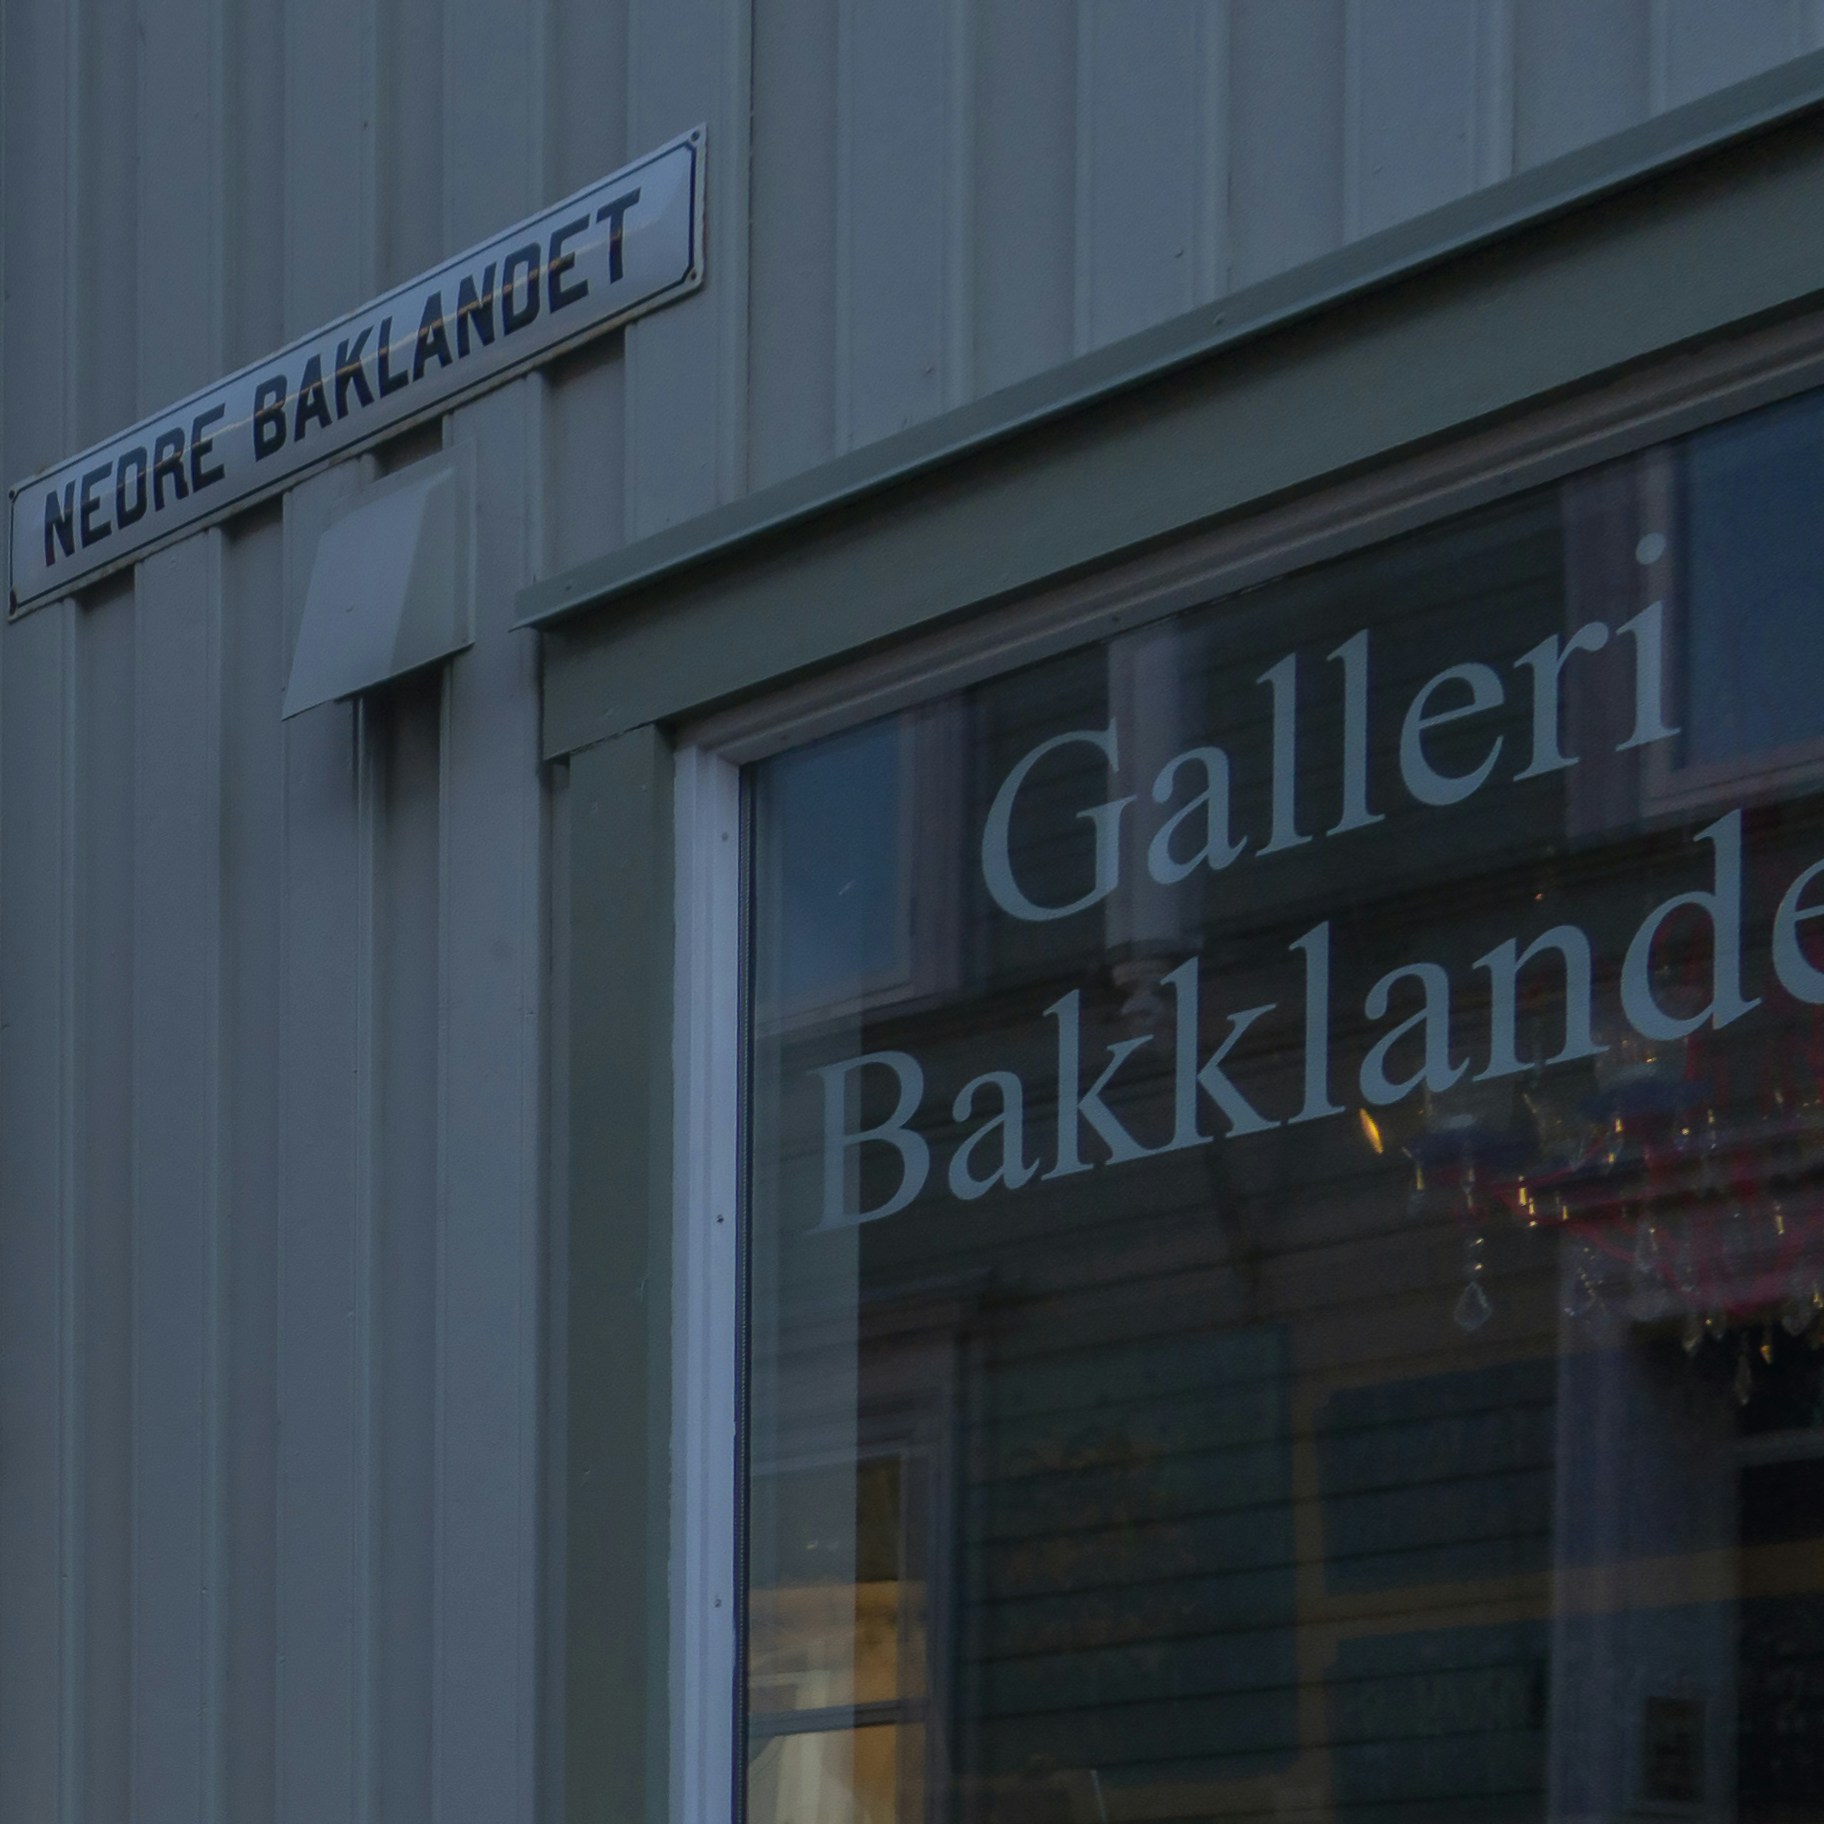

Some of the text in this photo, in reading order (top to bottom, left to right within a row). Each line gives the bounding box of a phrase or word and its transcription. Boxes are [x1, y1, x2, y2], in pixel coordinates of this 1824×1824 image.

[43, 186, 643, 567] NEDRE BAKLANDET
[980, 532, 1682, 923] Galleri
